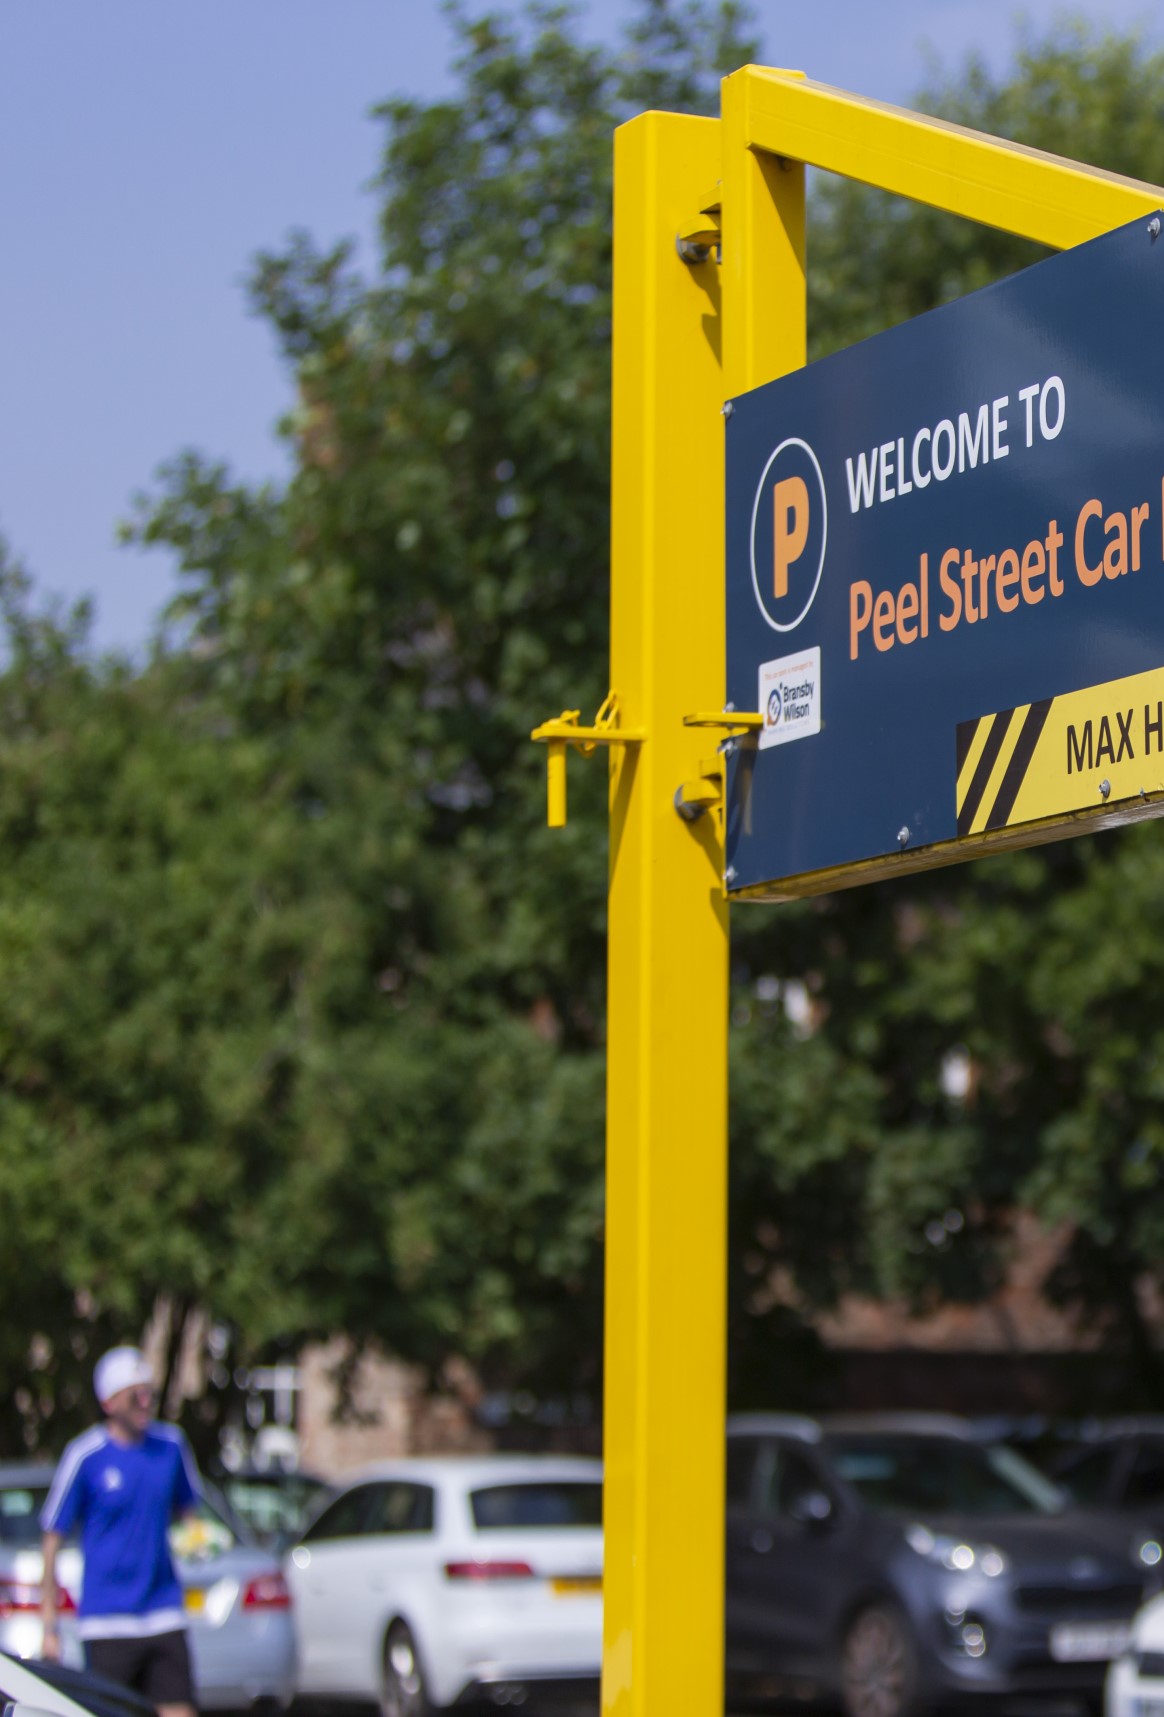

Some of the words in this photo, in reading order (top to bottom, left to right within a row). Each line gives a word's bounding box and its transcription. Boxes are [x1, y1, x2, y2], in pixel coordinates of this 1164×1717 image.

[845, 395, 1010, 514] WELCOME
[1018, 375, 1066, 448] TO
[773, 476, 810, 599] P
[850, 552, 929, 661] Peel
[939, 519, 1064, 633] Street
[1074, 498, 1150, 587] Car
[783, 680, 815, 703] Bransby
[783, 703, 811, 722] Wilson
[1066, 708, 1135, 775] MAX
